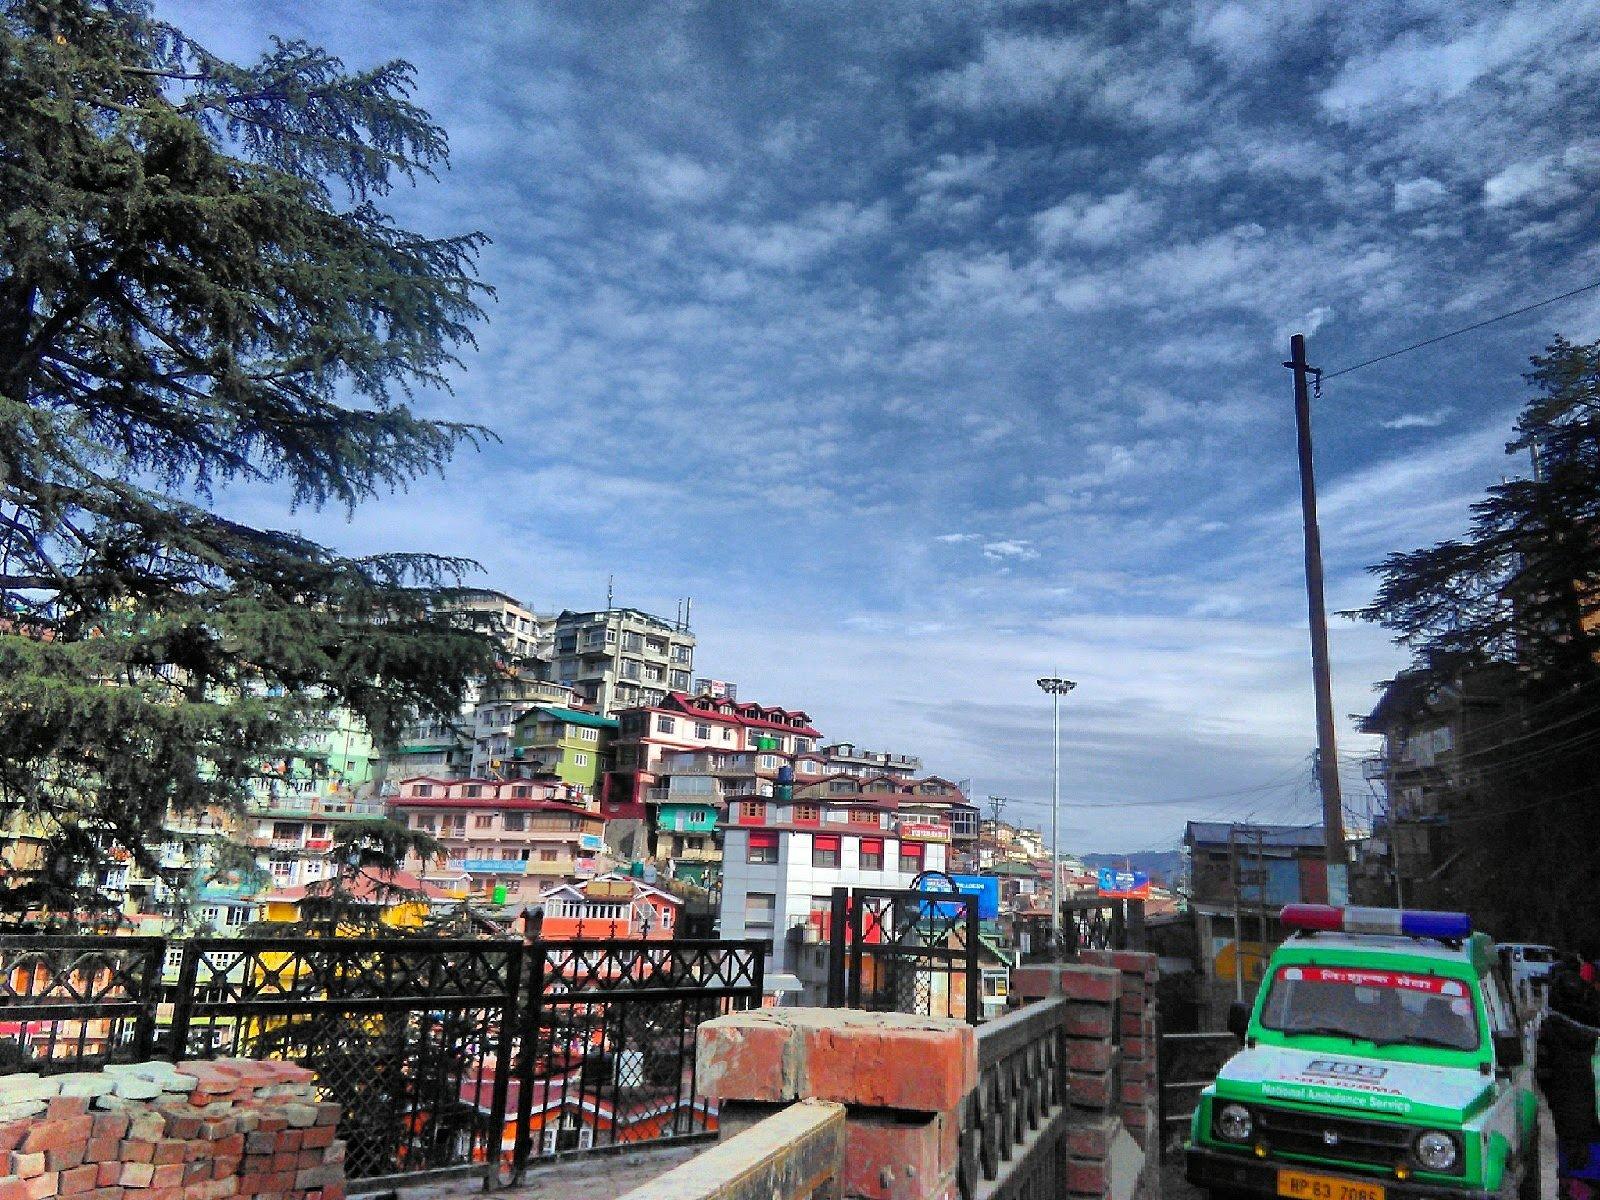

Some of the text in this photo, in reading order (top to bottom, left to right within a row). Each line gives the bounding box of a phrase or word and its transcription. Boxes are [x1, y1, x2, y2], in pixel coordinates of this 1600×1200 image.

[1261, 1082, 1305, 1099] National
[1308, 1089, 1367, 1107] Ambulance
[1369, 1096, 1411, 1113] Service
[1290, 1177, 1308, 1193] HP
[1312, 1181, 1331, 1199] 63
